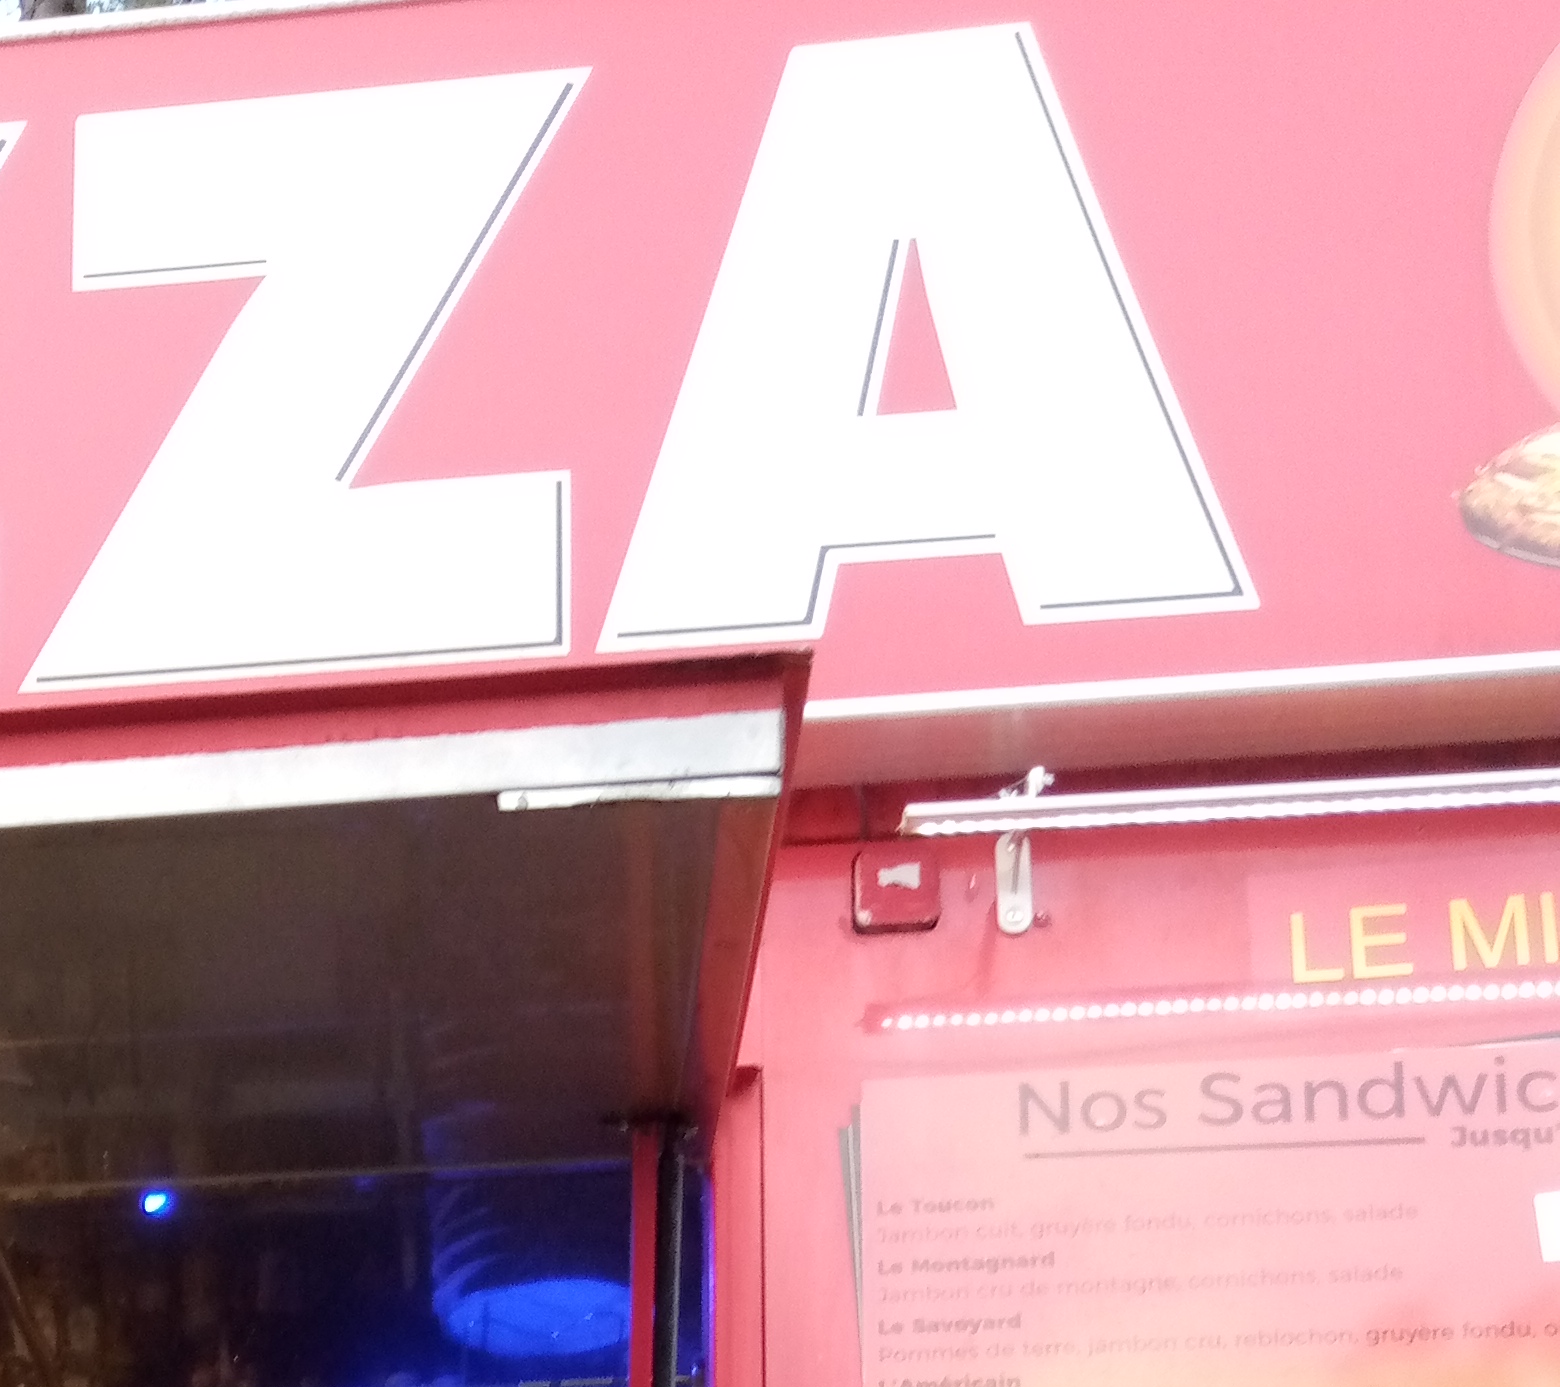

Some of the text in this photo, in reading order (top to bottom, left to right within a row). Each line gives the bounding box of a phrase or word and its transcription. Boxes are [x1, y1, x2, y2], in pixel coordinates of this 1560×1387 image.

[1289, 892, 1560, 984] LE MI
[1017, 1054, 1559, 1138] Nos Sandwic
[1342, 1203, 1419, 1223] salade
[911, 1251, 1056, 1275] Montagnard
[1328, 1263, 1403, 1284] salade
[912, 1311, 1022, 1335] Savoyard
[1365, 1325, 1455, 1347] gruyère
